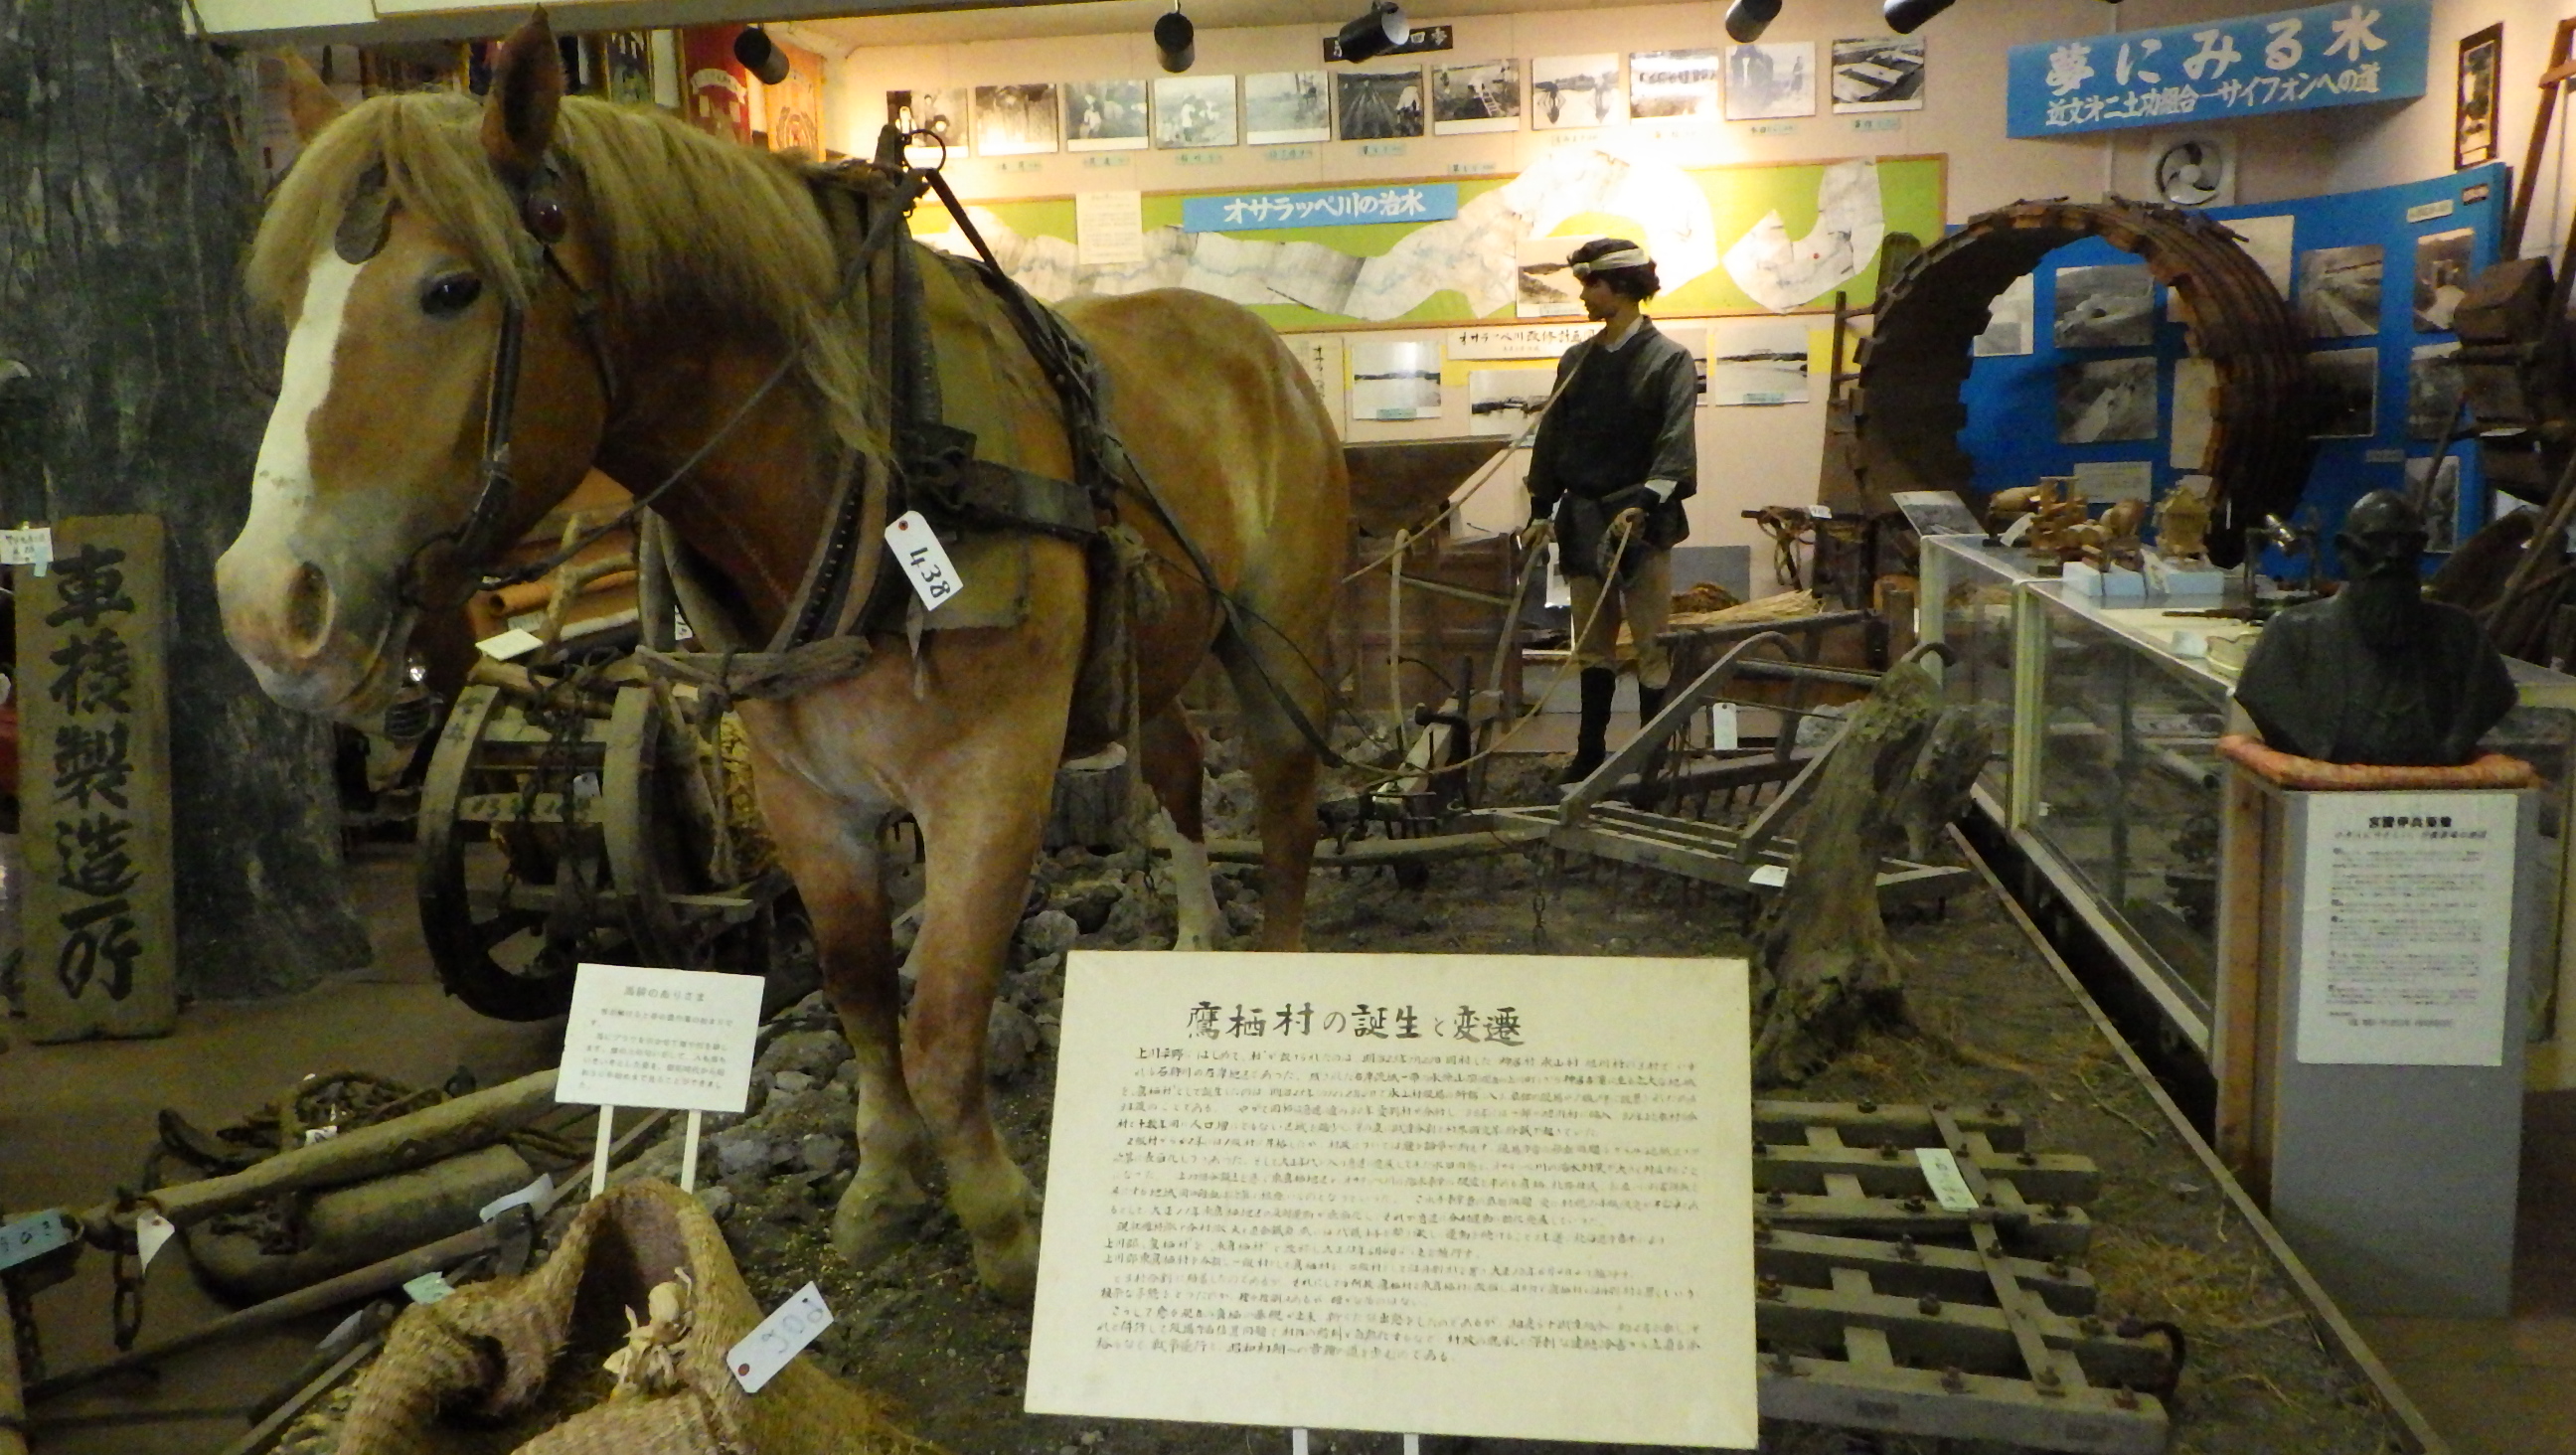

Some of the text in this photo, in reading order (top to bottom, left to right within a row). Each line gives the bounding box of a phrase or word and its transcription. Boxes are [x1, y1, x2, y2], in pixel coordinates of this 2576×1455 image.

[2045, 4, 2387, 96] 夢にみる水
[1223, 188, 1426, 224] オサラッペ川の治水
[910, 547, 951, 598] 438
[1188, 1001, 1525, 1047] 鷹栖村の誕生と変遷
